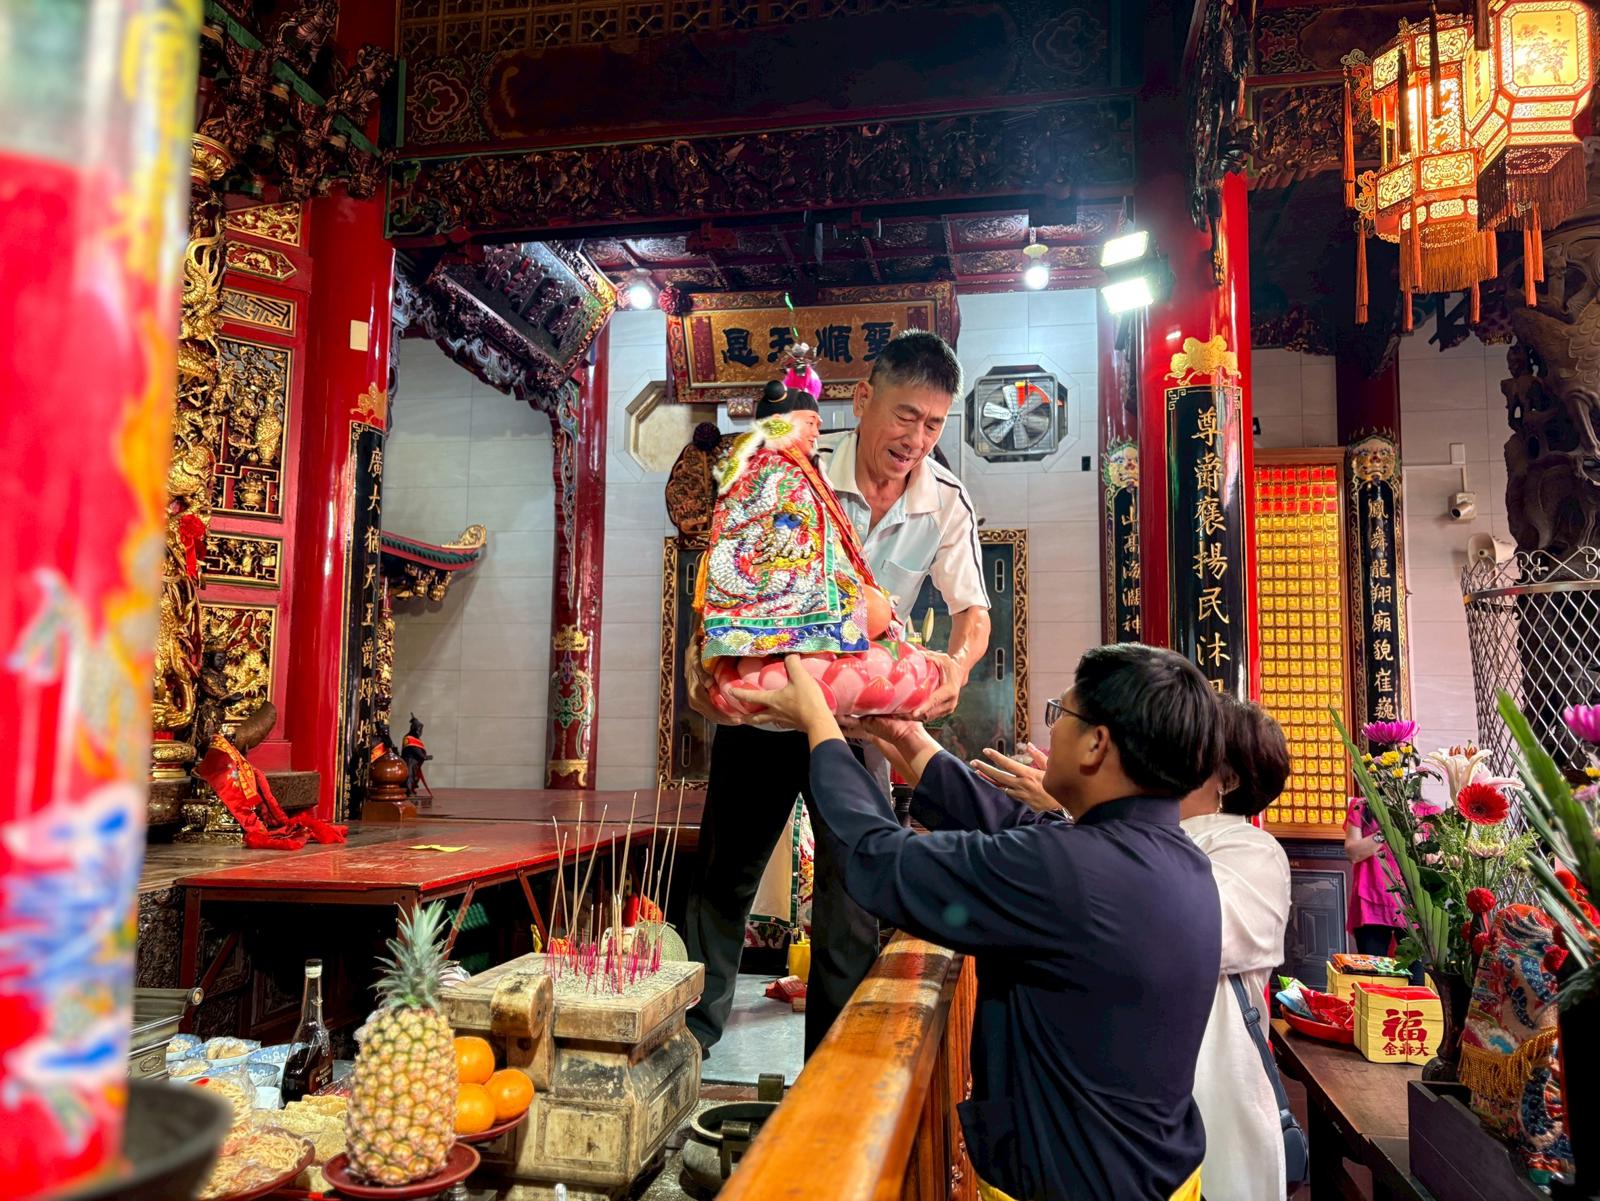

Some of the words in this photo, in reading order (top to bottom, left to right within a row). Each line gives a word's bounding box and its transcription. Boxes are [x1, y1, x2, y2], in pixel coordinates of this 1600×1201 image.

[1190, 406, 1231, 694] 尊爵褒揚民沐
[1381, 1008, 1428, 1041] 福
